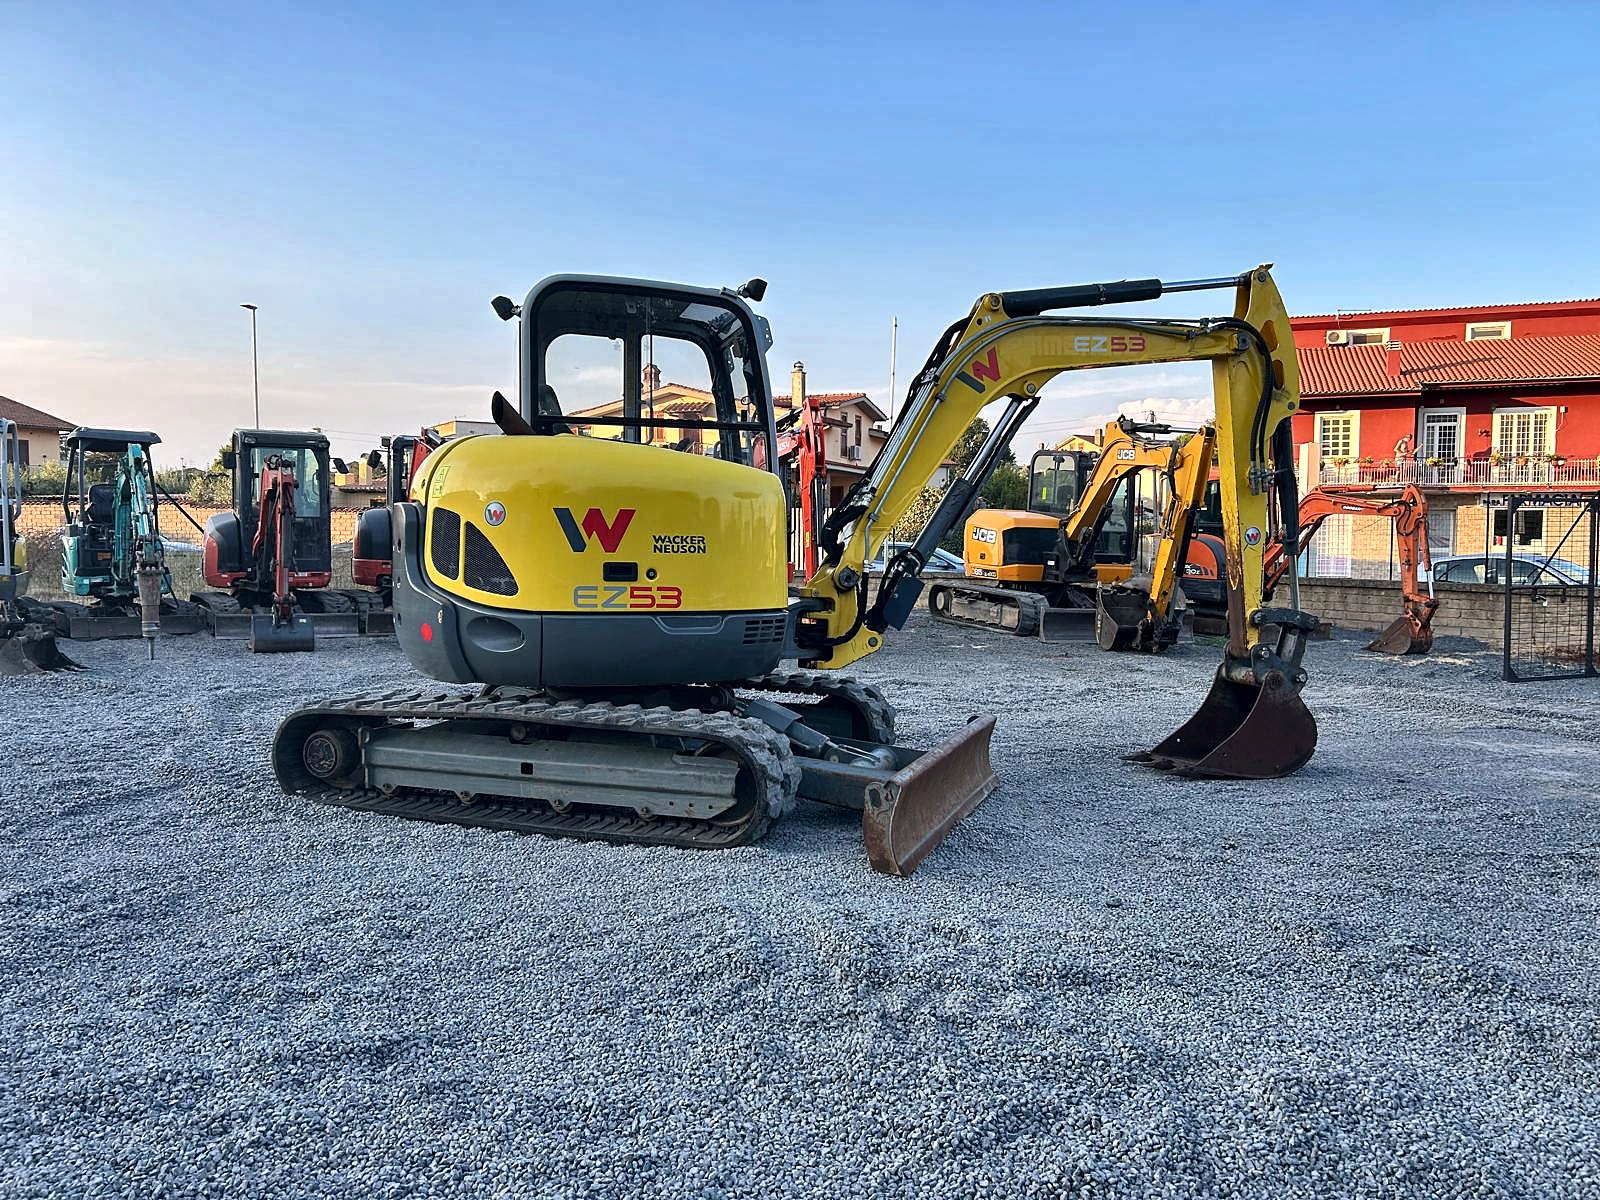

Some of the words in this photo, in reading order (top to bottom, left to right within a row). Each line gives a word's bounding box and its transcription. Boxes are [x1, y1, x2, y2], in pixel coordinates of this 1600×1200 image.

[1073, 336, 1146, 352] EZ53
[1117, 449, 1136, 460] JCB
[1502, 494, 1580, 506] FRMACIA
[653, 535, 706, 545] WACKER
[972, 526, 997, 544] JCB
[653, 544, 707, 554] NEUSON
[573, 586, 683, 609] EZ53
